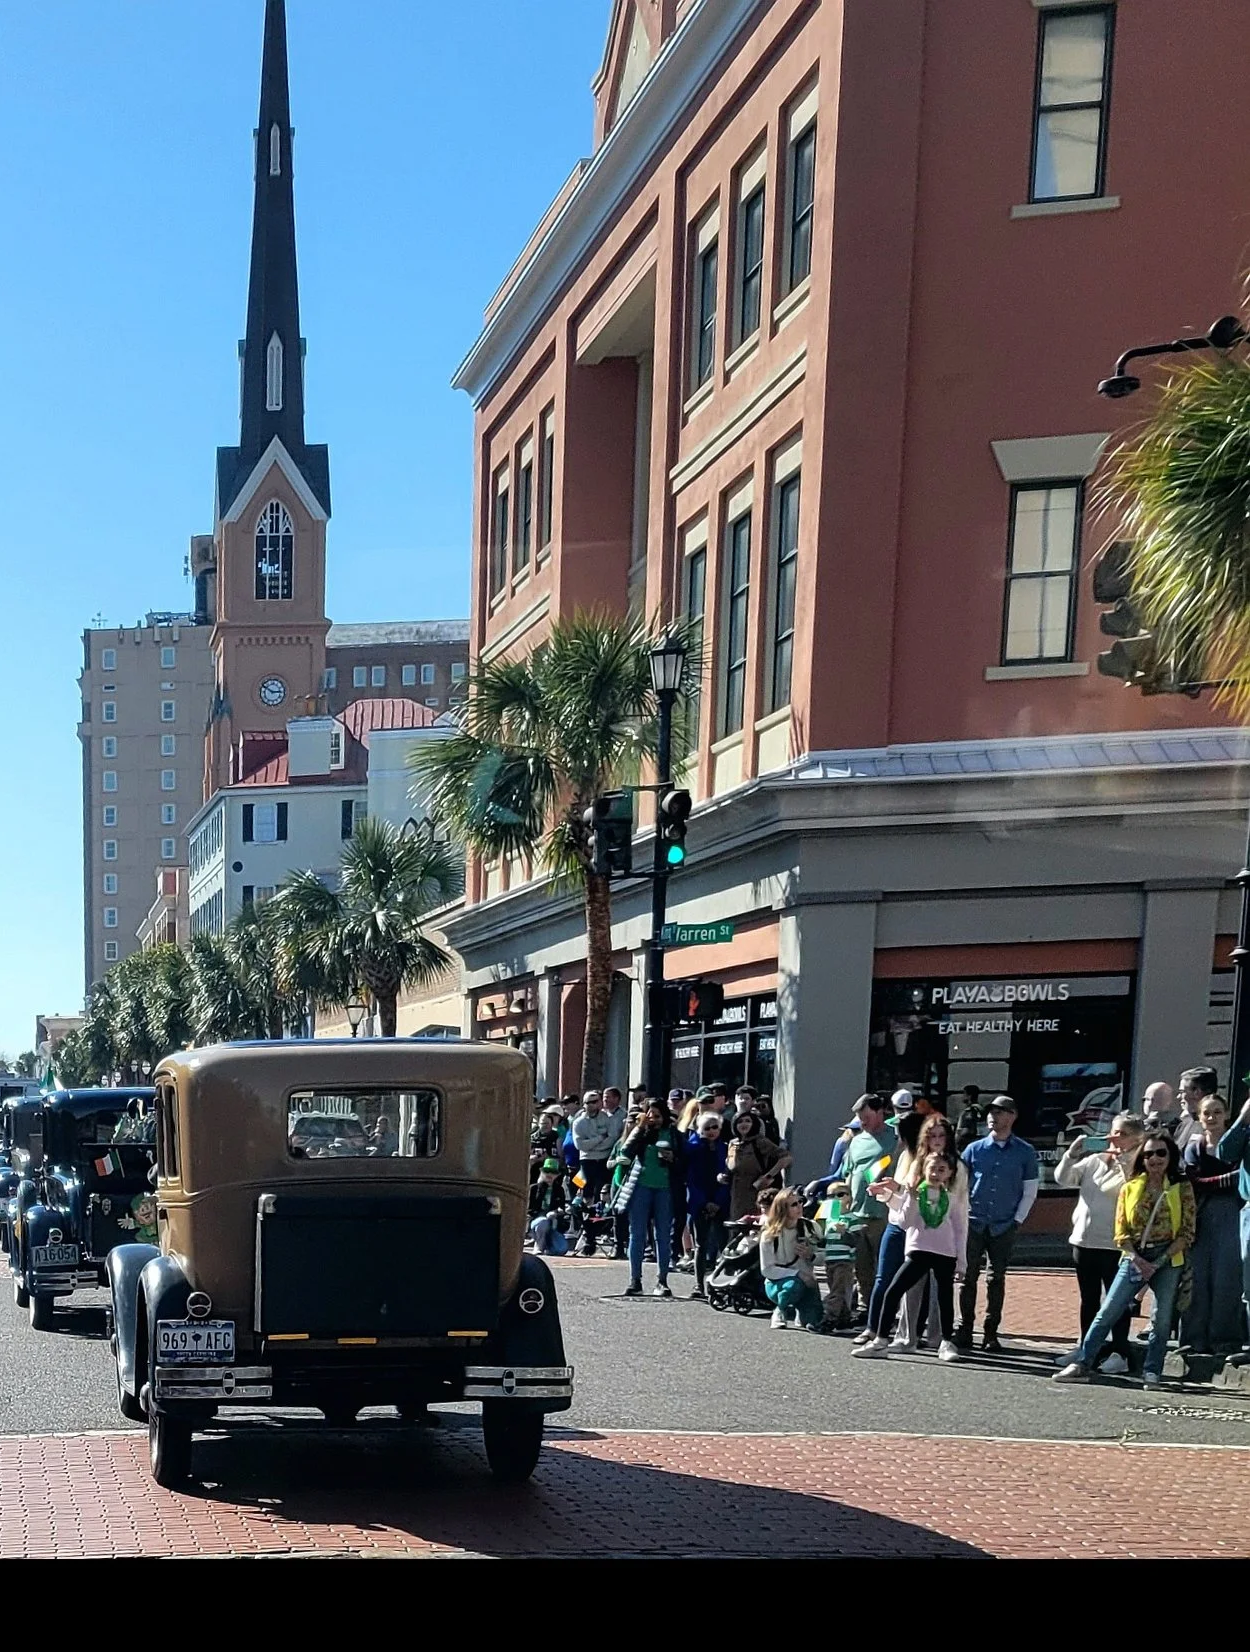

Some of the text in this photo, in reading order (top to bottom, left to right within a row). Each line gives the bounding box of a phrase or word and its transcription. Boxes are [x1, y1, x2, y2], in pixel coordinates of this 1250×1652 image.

[720, 925, 729, 935] St
[932, 984, 1070, 1004] PLAYA BOWLS
[938, 1019, 1060, 1034] EAT HEALTHY HERE
[162, 1332, 231, 1349] 969 AFC
